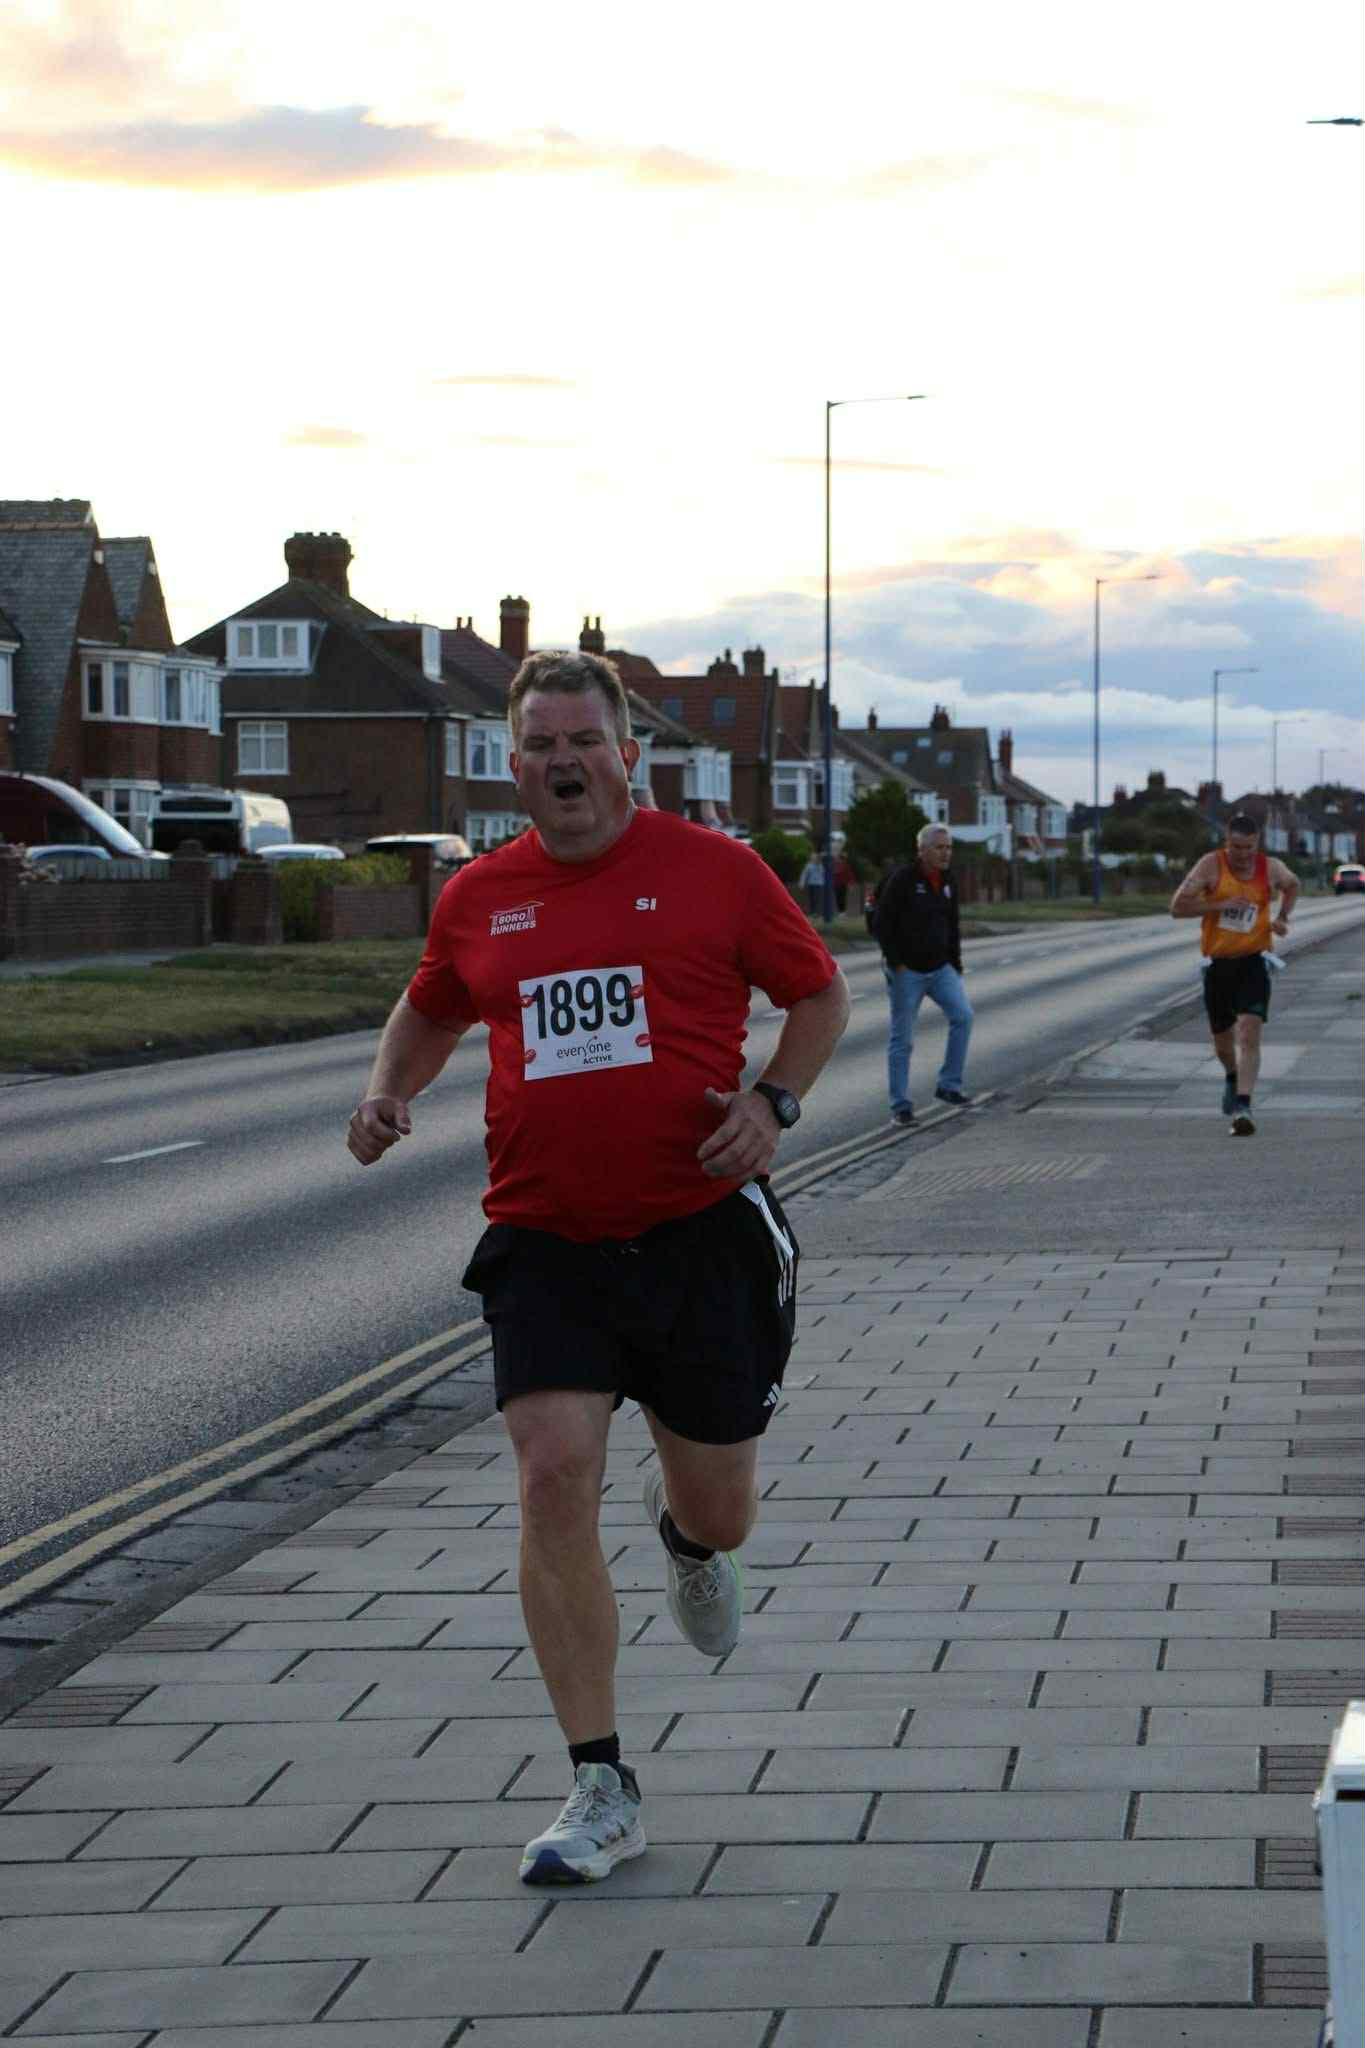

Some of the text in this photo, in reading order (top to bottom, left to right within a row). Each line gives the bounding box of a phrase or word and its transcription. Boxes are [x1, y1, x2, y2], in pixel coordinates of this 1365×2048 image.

[498, 912, 527, 925] BORO
[490, 919, 537, 937] RUNNERS
[532, 973, 635, 1040] 1899
[556, 1036, 612, 1059] everyone
[583, 1055, 613, 1065] ACTIVE
